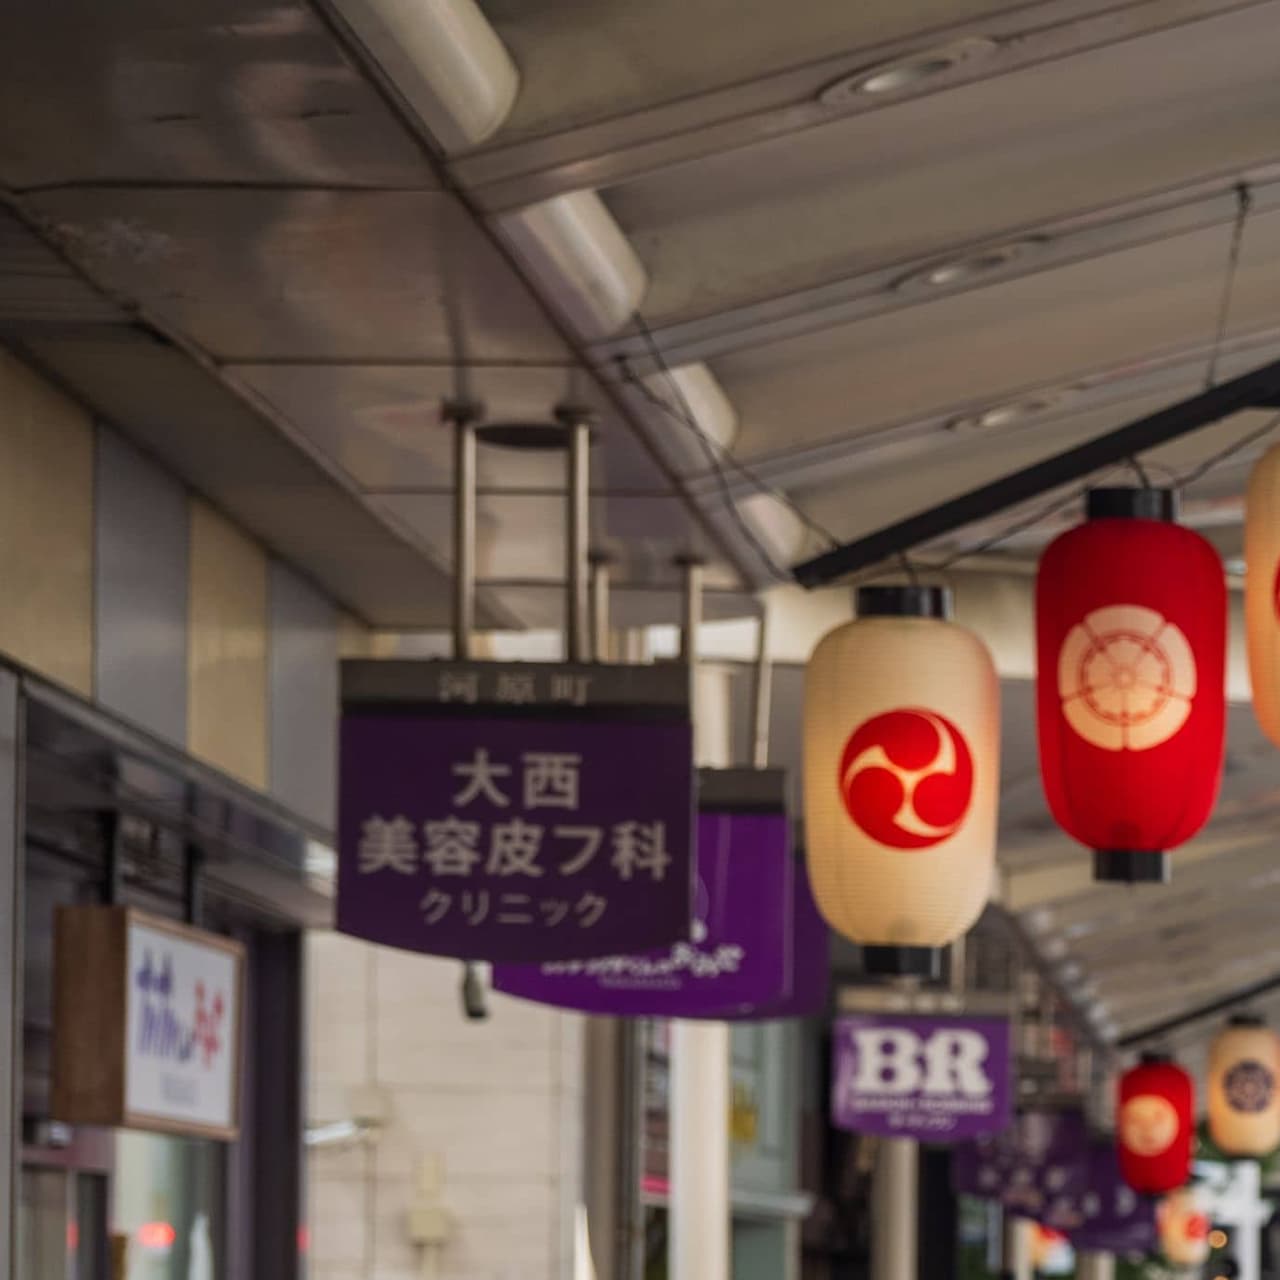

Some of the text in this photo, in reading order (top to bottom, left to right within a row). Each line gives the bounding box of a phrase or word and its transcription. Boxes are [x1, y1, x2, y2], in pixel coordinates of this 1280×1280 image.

[439, 671, 592, 705] 河原町
[452, 749, 583, 809] 大西
[357, 814, 672, 881] 美容皮フ科
[418, 888, 608, 928] クリニック
[853, 1027, 994, 1097] BR
